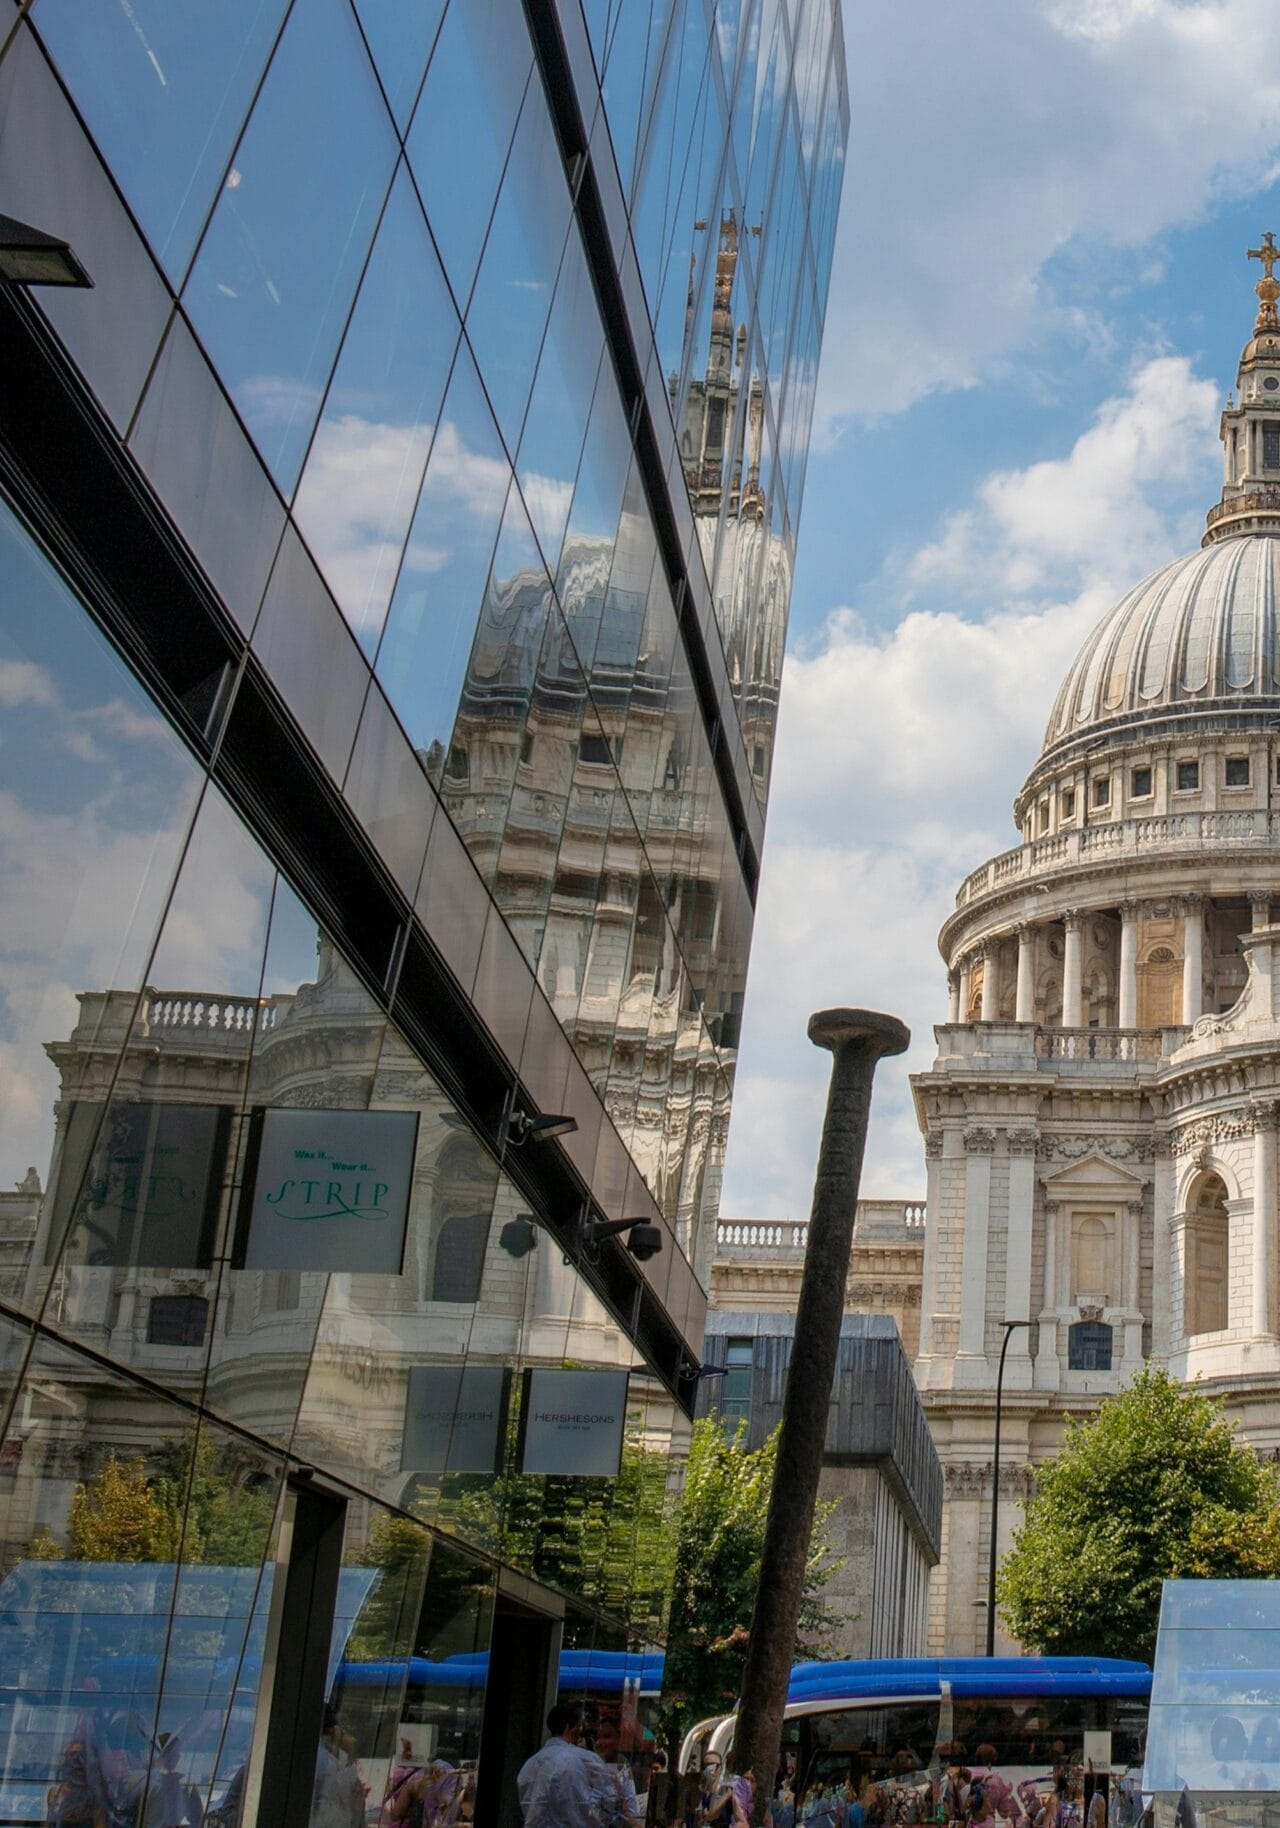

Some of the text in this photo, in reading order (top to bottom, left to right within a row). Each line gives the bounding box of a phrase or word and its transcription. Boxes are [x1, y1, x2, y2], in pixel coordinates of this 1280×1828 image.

[294, 1150, 315, 1159] Wax
[332, 1162, 358, 1171] Wear
[266, 1180, 389, 1220] STRIP
[535, 1412, 615, 1424] HERSHESONS
